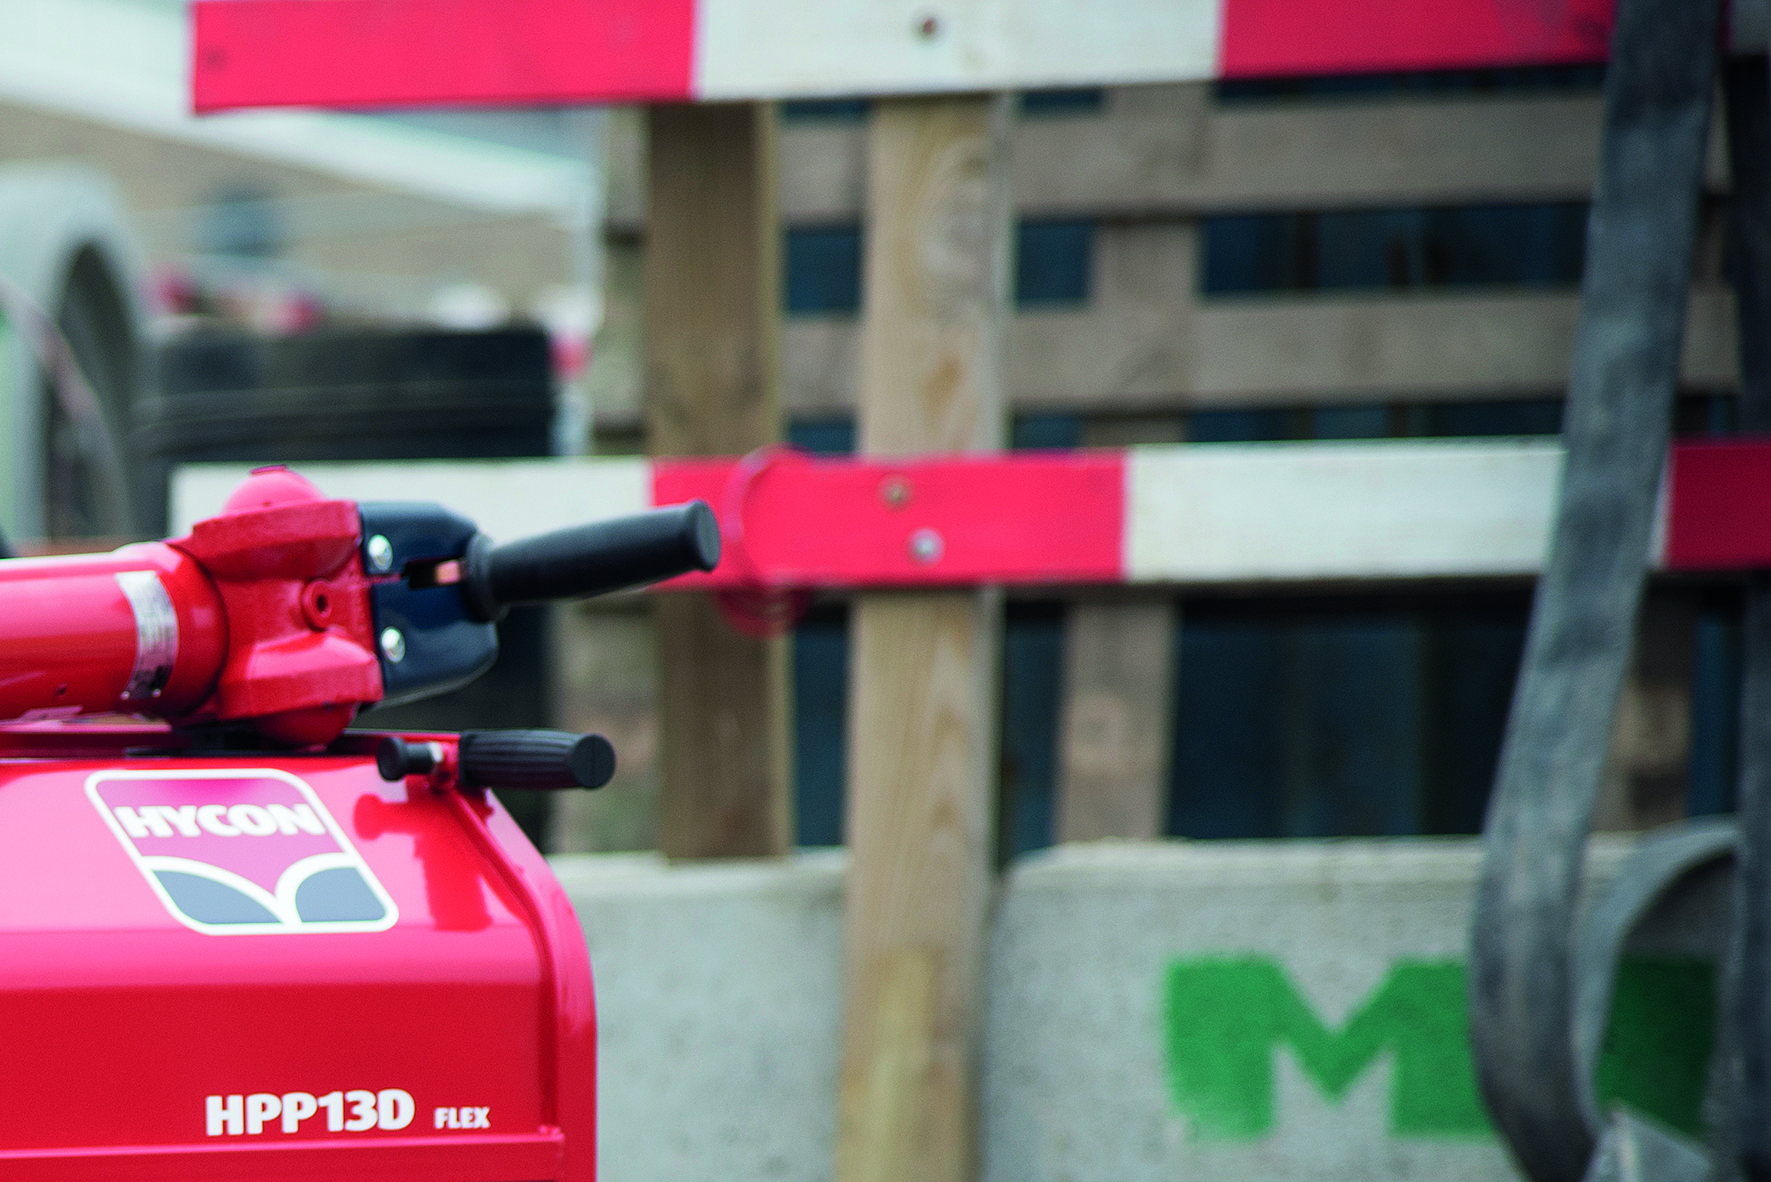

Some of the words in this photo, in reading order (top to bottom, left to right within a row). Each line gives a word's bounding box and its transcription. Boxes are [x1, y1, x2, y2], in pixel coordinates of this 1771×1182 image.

[114, 803, 327, 838] HYCON
[205, 1088, 416, 1137] HPP13D
[434, 1106, 491, 1130] FLEX
